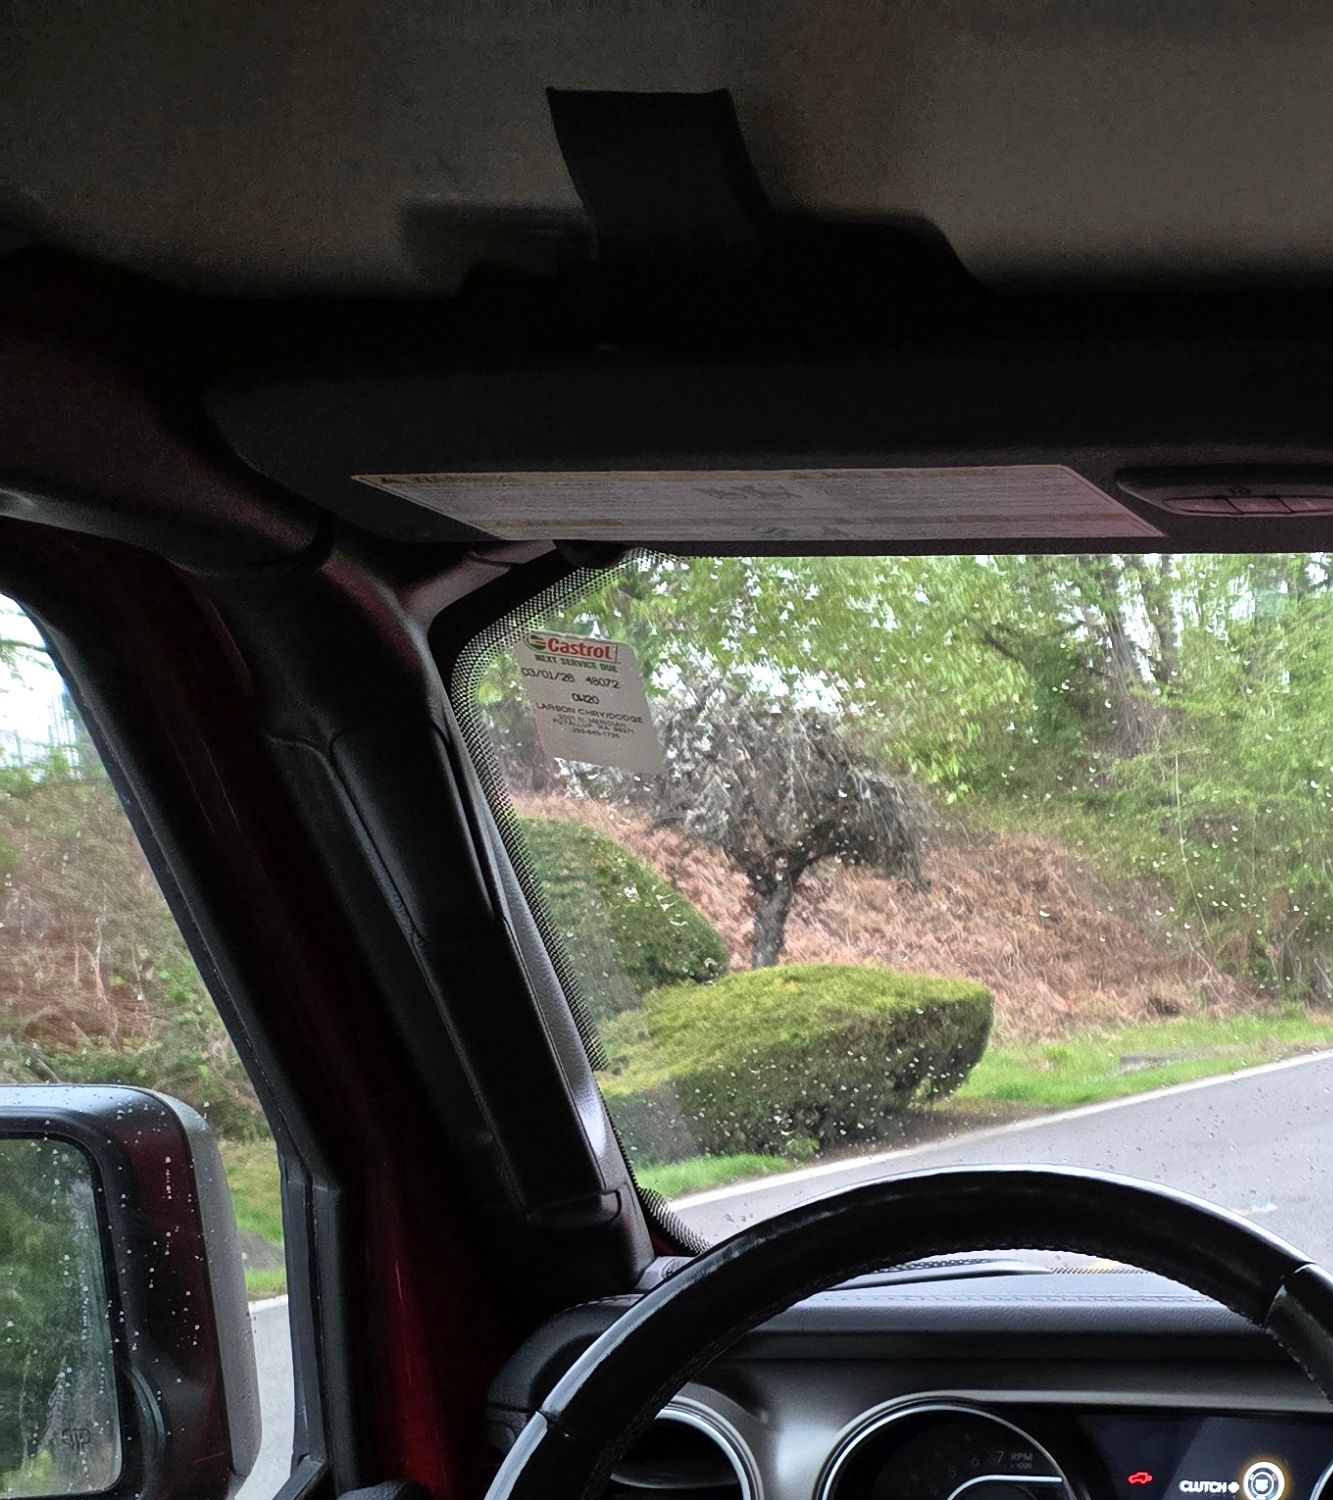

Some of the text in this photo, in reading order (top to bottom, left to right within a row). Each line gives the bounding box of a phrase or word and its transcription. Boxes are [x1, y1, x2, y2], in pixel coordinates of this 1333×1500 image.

[547, 637, 612, 660] Castrol
[535, 654, 618, 673] NEXT SERVICE DUE
[1011, 1452, 1034, 1462] RPM
[1180, 1480, 1228, 1493] CLUTCH
